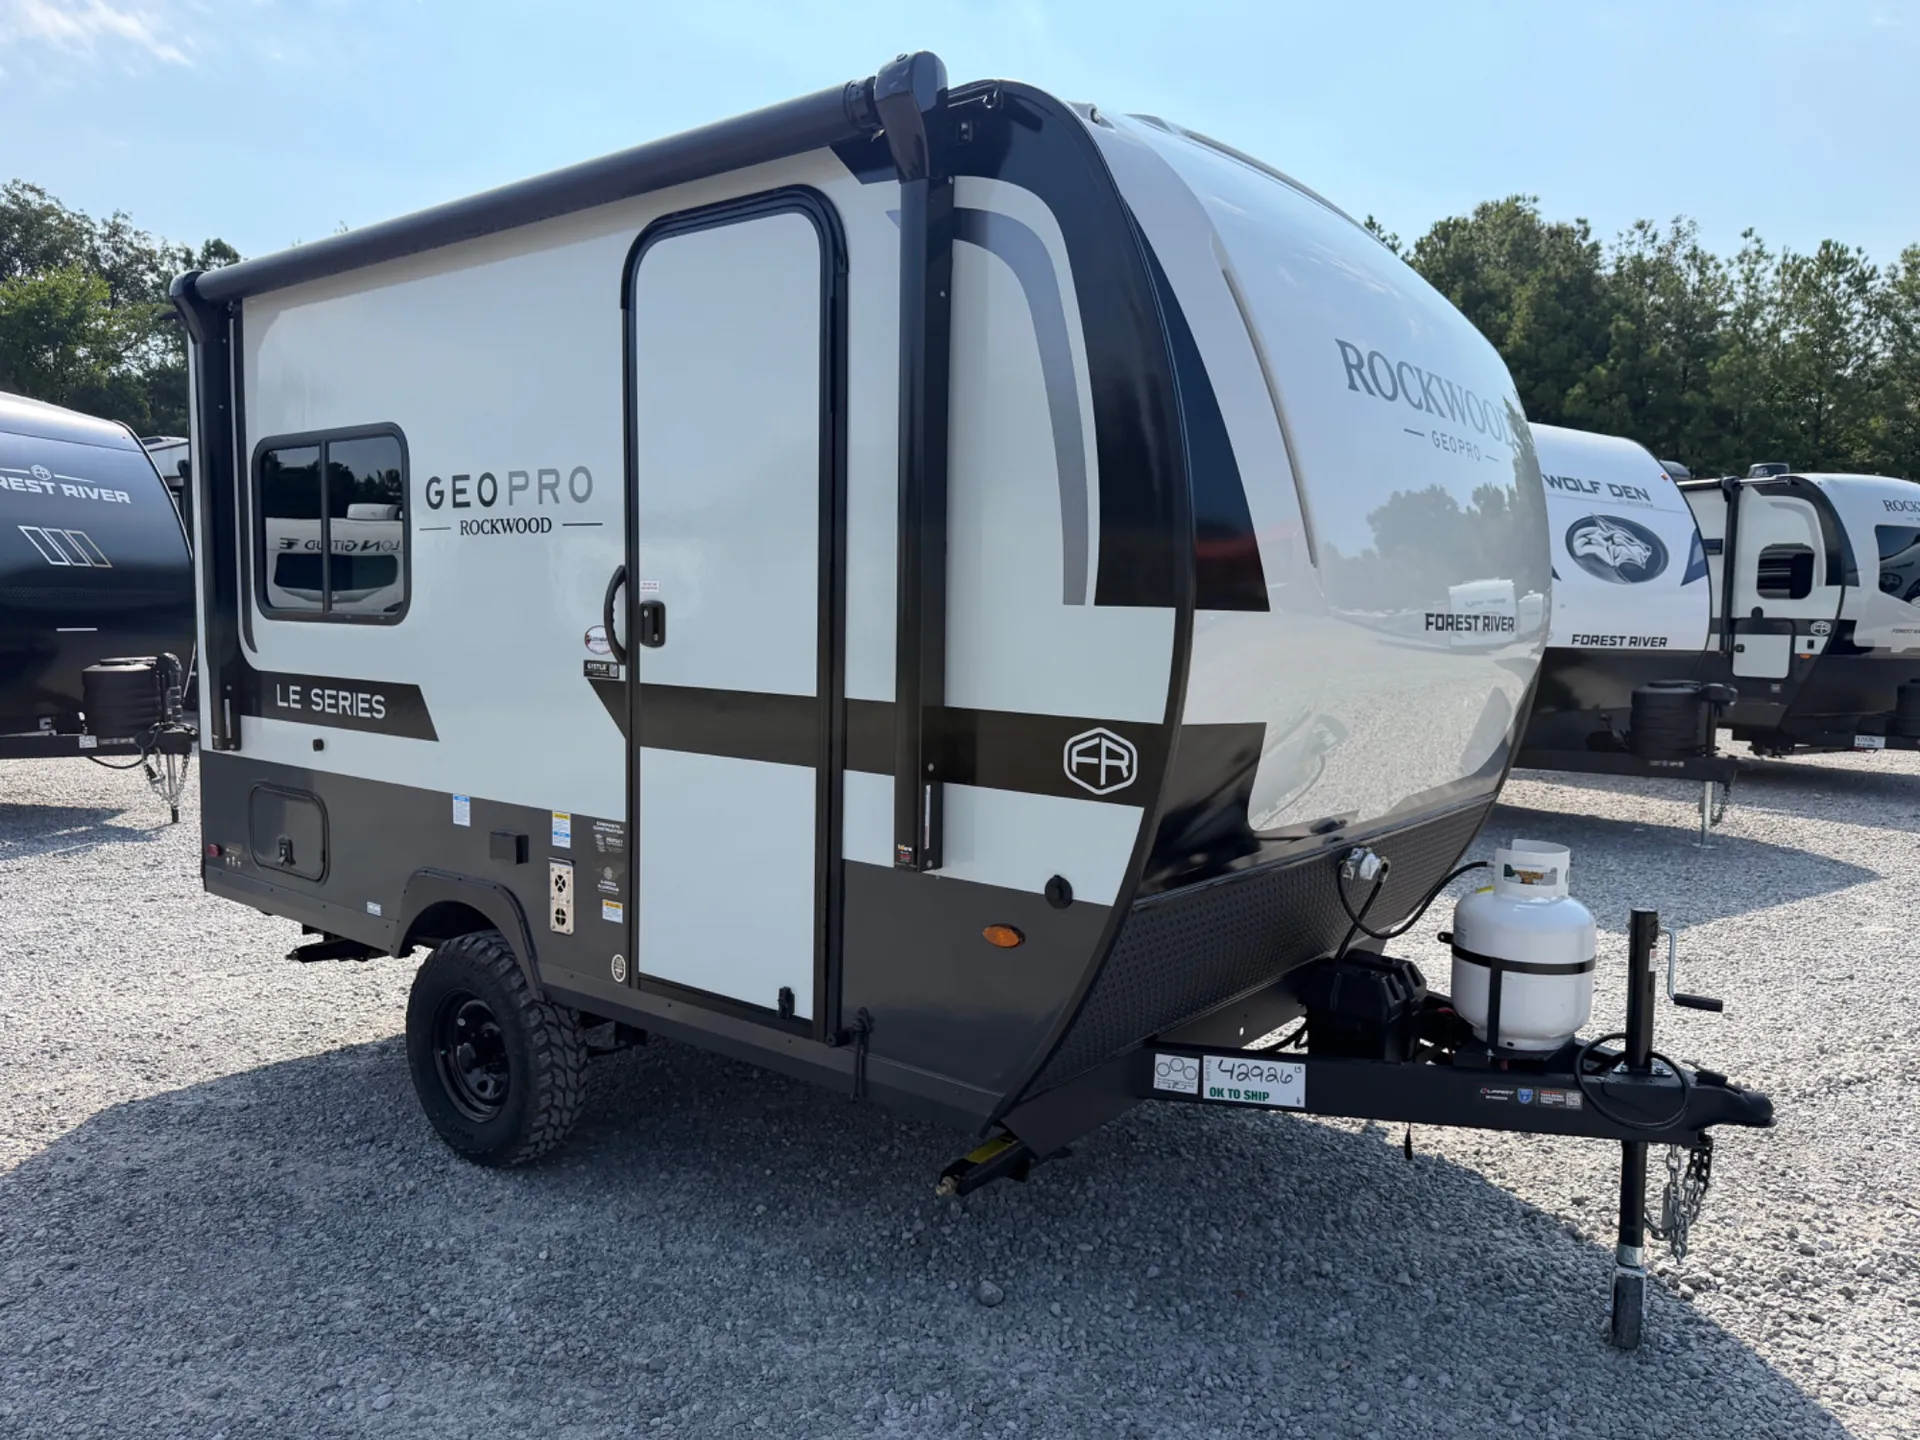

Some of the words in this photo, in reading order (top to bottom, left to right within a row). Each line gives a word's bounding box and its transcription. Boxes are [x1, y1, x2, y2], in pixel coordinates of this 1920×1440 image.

[1335, 338, 1514, 447] ROCKWOOD
[1432, 430, 1481, 462] GEOPRO
[60, 483, 132, 504] RIVER
[1542, 474, 1601, 494] WOLF
[1607, 482, 1652, 502] DEN
[460, 517, 552, 536] ROCKWOOD
[1425, 612, 1480, 632] FOREST
[1482, 615, 1515, 632] RIVER
[1571, 633, 1627, 647] FOREST
[1628, 636, 1668, 648] RIVER
[276, 683, 302, 709] LE
[310, 687, 386, 719] SERIES
[1217, 1059, 1294, 1085] 42926
[1209, 1086, 1225, 1098] OK
[1228, 1088, 1241, 1100] TO
[1243, 1089, 1270, 1102] SHIP
